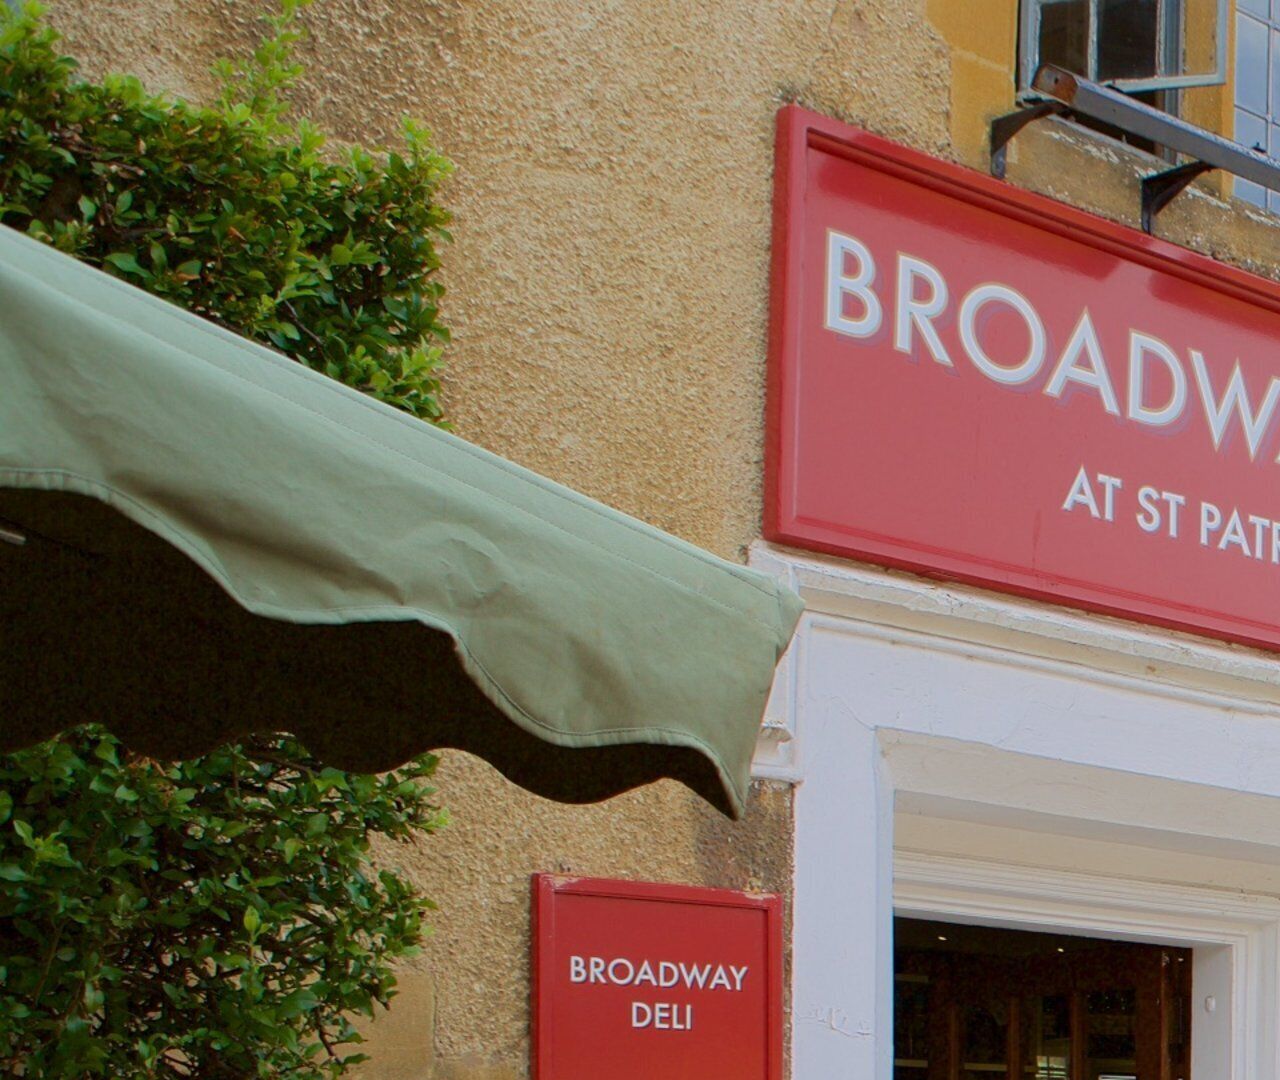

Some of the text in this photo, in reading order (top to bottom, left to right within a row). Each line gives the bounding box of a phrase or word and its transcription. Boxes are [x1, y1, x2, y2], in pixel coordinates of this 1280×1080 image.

[1061, 465, 1122, 522] AT
[1137, 485, 1187, 537] ST
[569, 956, 748, 992] BROADWAY
[631, 1002, 693, 1030] DELI
